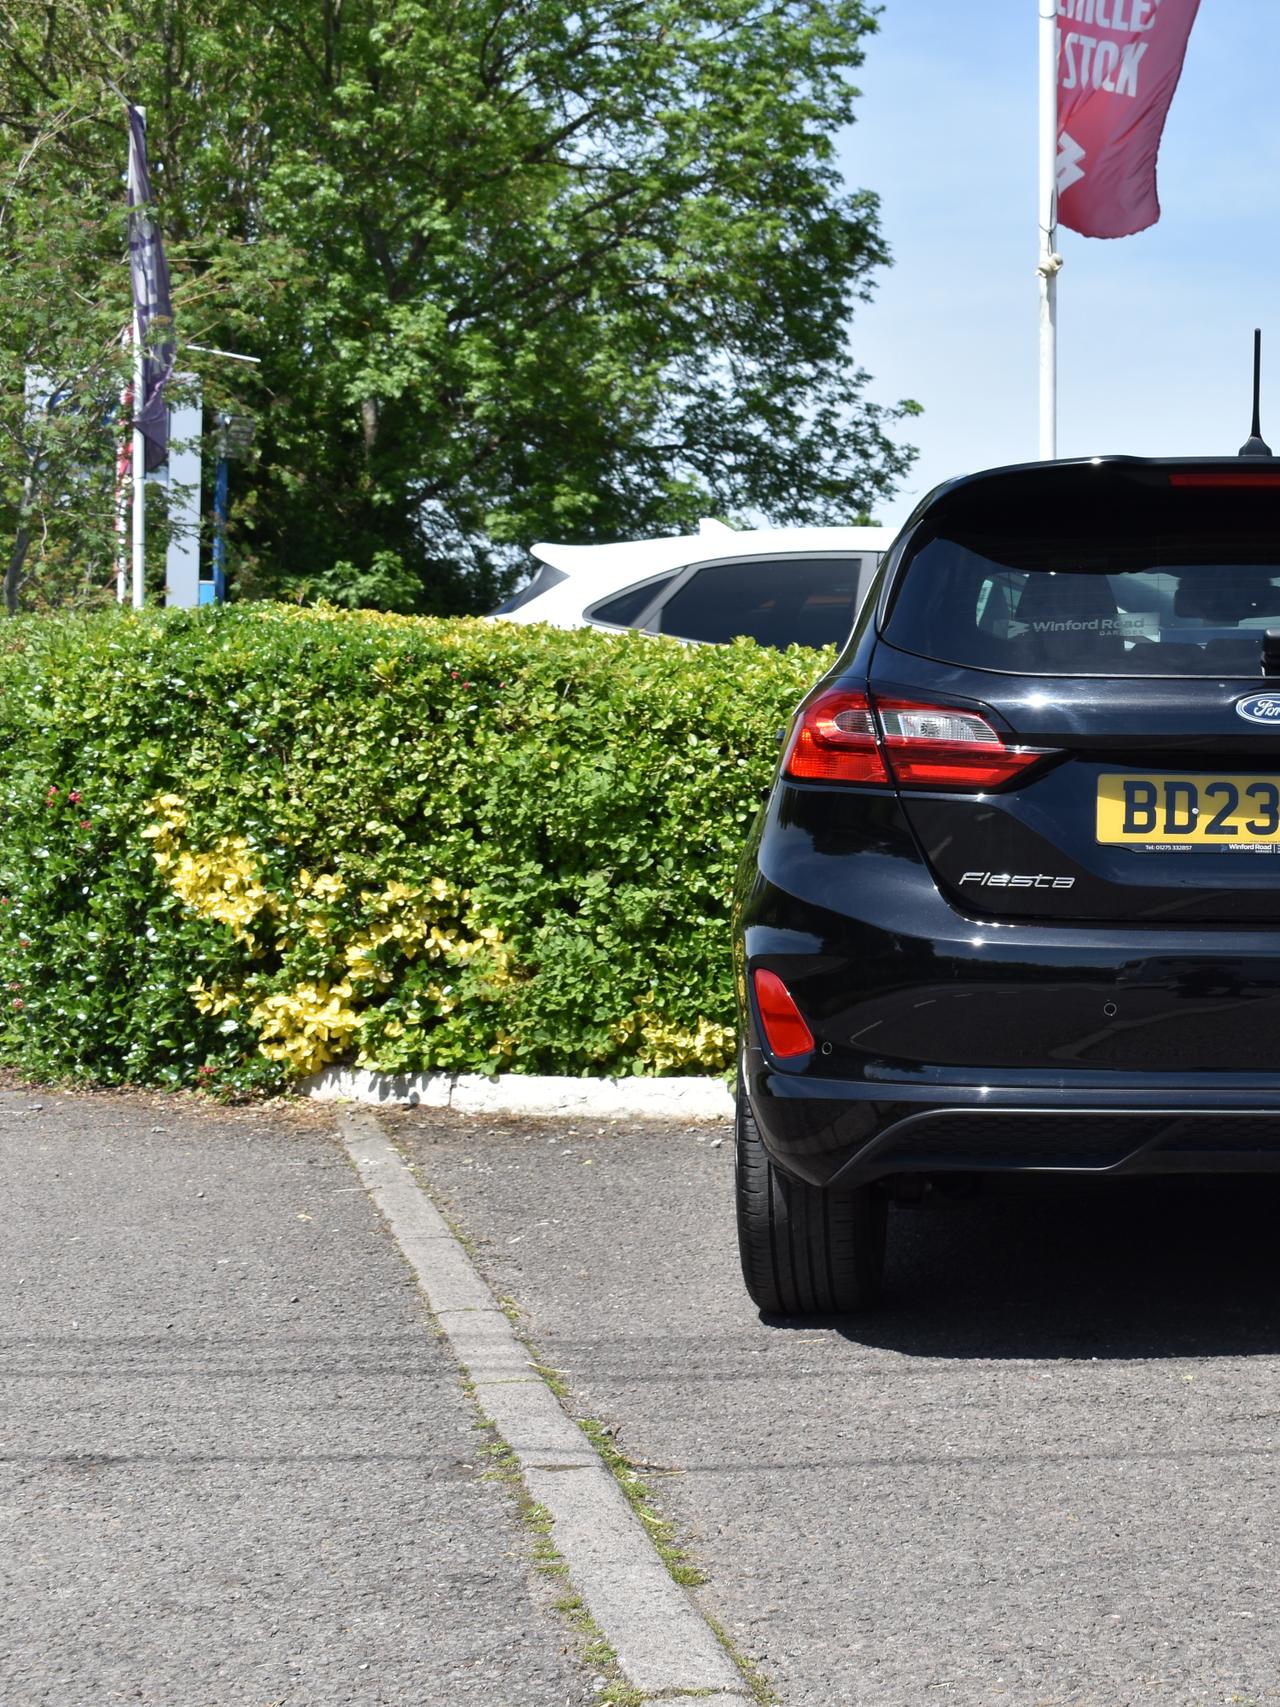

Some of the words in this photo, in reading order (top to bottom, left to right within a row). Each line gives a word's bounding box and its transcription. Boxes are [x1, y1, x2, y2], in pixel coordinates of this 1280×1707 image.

[1033, 619, 1098, 632] Winford
[1101, 618, 1145, 630] Road
[1122, 781, 1280, 837] BD23
